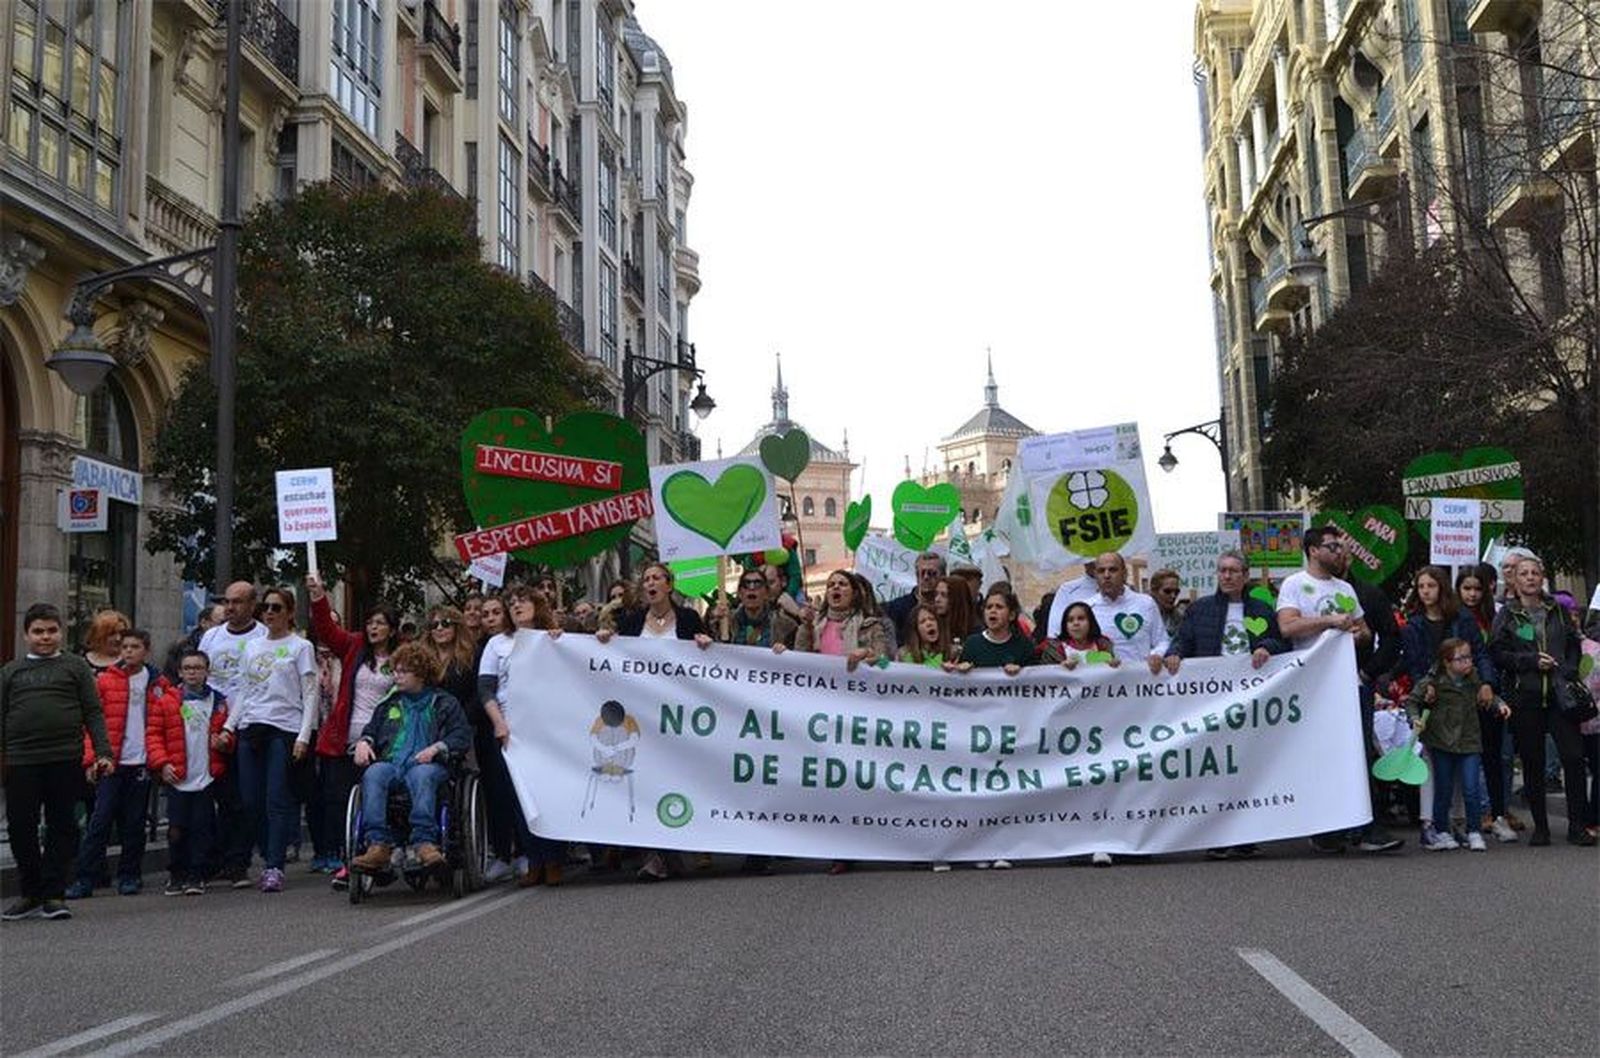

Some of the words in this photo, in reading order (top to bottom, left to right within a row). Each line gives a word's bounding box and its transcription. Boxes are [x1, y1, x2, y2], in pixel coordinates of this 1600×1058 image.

[295, 520, 332, 532] Especial
[463, 517, 561, 557] ESPECIAL
[1059, 509, 1132, 546] FSIE
[1365, 516, 1396, 545] PARA
[1443, 545, 1476, 557] Especial
[588, 657, 613, 673] LA
[622, 660, 740, 681] EDUCACIÓN
[748, 669, 838, 691] ESPECIAL
[847, 679, 868, 693] ES
[876, 682, 918, 697] UNA
[929, 684, 1072, 699] HERRAMIENTA
[1080, 685, 1101, 699] DE
[1107, 683, 1129, 698] LA
[1136, 677, 1234, 698] INCLUSIÓN
[659, 703, 717, 737] NO
[739, 708, 786, 740] AL
[807, 712, 948, 752] CIERRE
[970, 723, 1017, 755] DE
[1038, 726, 1104, 756] LOS
[1122, 694, 1302, 749] COLEGIOS
[733, 752, 779, 786] DE
[801, 757, 1044, 793] EDUCACIÓN
[1065, 744, 1240, 788] ESPECIAL
[710, 809, 841, 825] PLATAFORMA
[852, 813, 968, 829] EDUCACIÓN
[978, 811, 1081, 828] INCLUSIVA
[1126, 804, 1209, 821] ESPECIAL
[1217, 793, 1296, 812] TAMBIÉN
